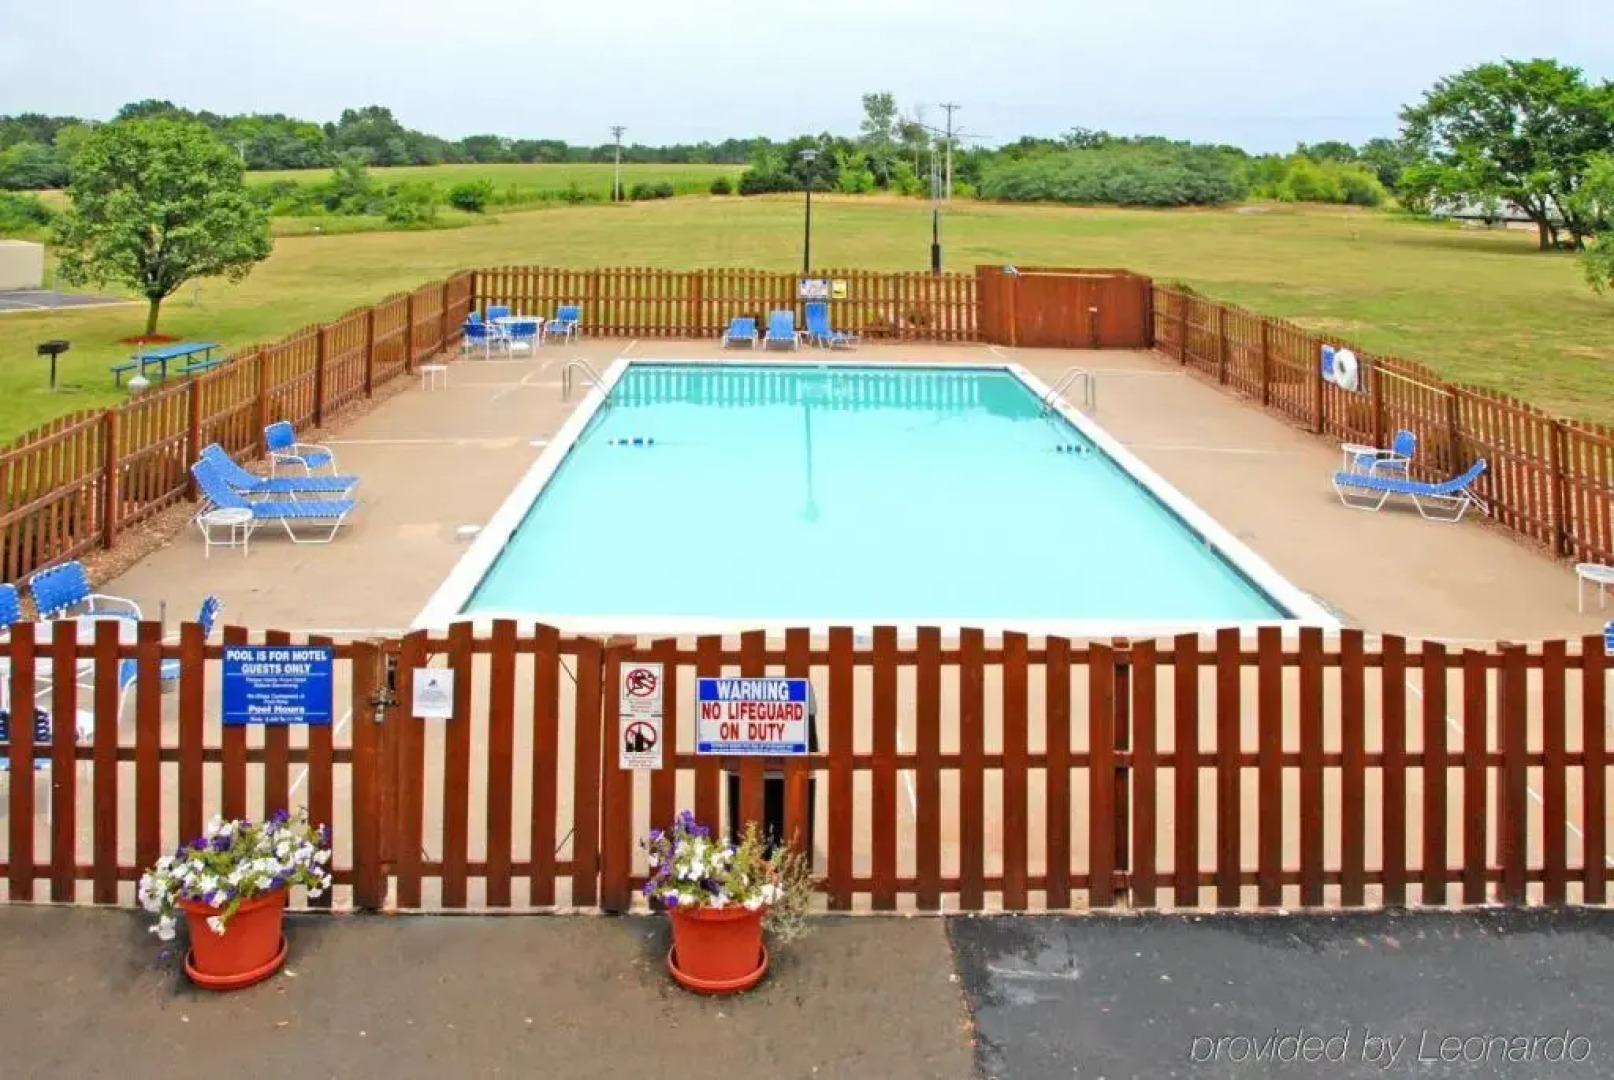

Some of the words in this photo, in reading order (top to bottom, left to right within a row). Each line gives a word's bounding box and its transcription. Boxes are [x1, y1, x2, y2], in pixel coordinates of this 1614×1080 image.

[226, 650, 254, 661] POOL
[256, 650, 267, 661] IS
[269, 650, 290, 661] FOR
[292, 650, 327, 661] MOTEL
[241, 664, 281, 674] GUESTS
[284, 664, 312, 674] ONLY
[716, 681, 789, 700] WARNING
[248, 705, 271, 714] Pool
[274, 705, 305, 714] Hours
[702, 702, 721, 720] NO
[728, 702, 803, 720] LIFEGUARD
[720, 722, 740, 740] ON
[748, 723, 785, 741] DUTY
